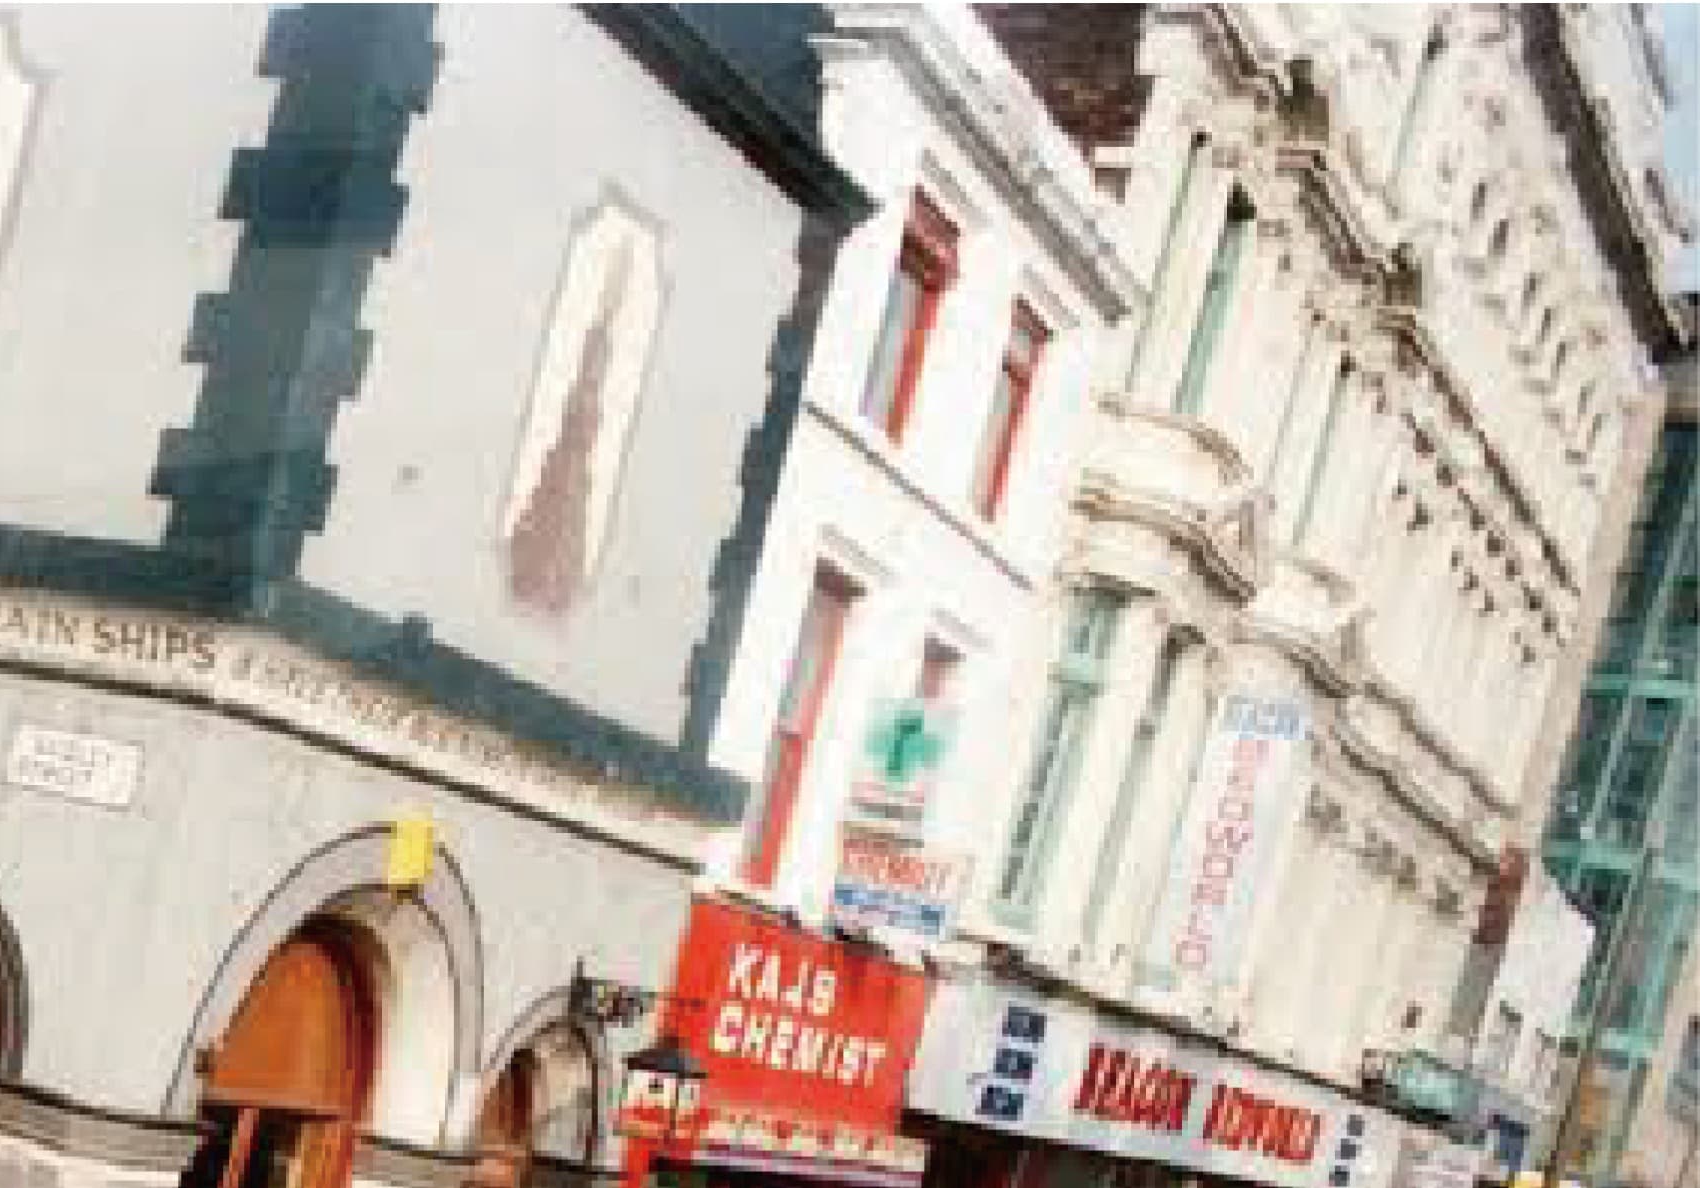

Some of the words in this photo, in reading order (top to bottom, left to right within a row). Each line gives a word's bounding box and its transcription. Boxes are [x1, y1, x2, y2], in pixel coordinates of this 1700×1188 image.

[36, 610, 77, 646] IN
[92, 616, 216, 669] SHIPS
[709, 1004, 888, 1089] CHEMIST
